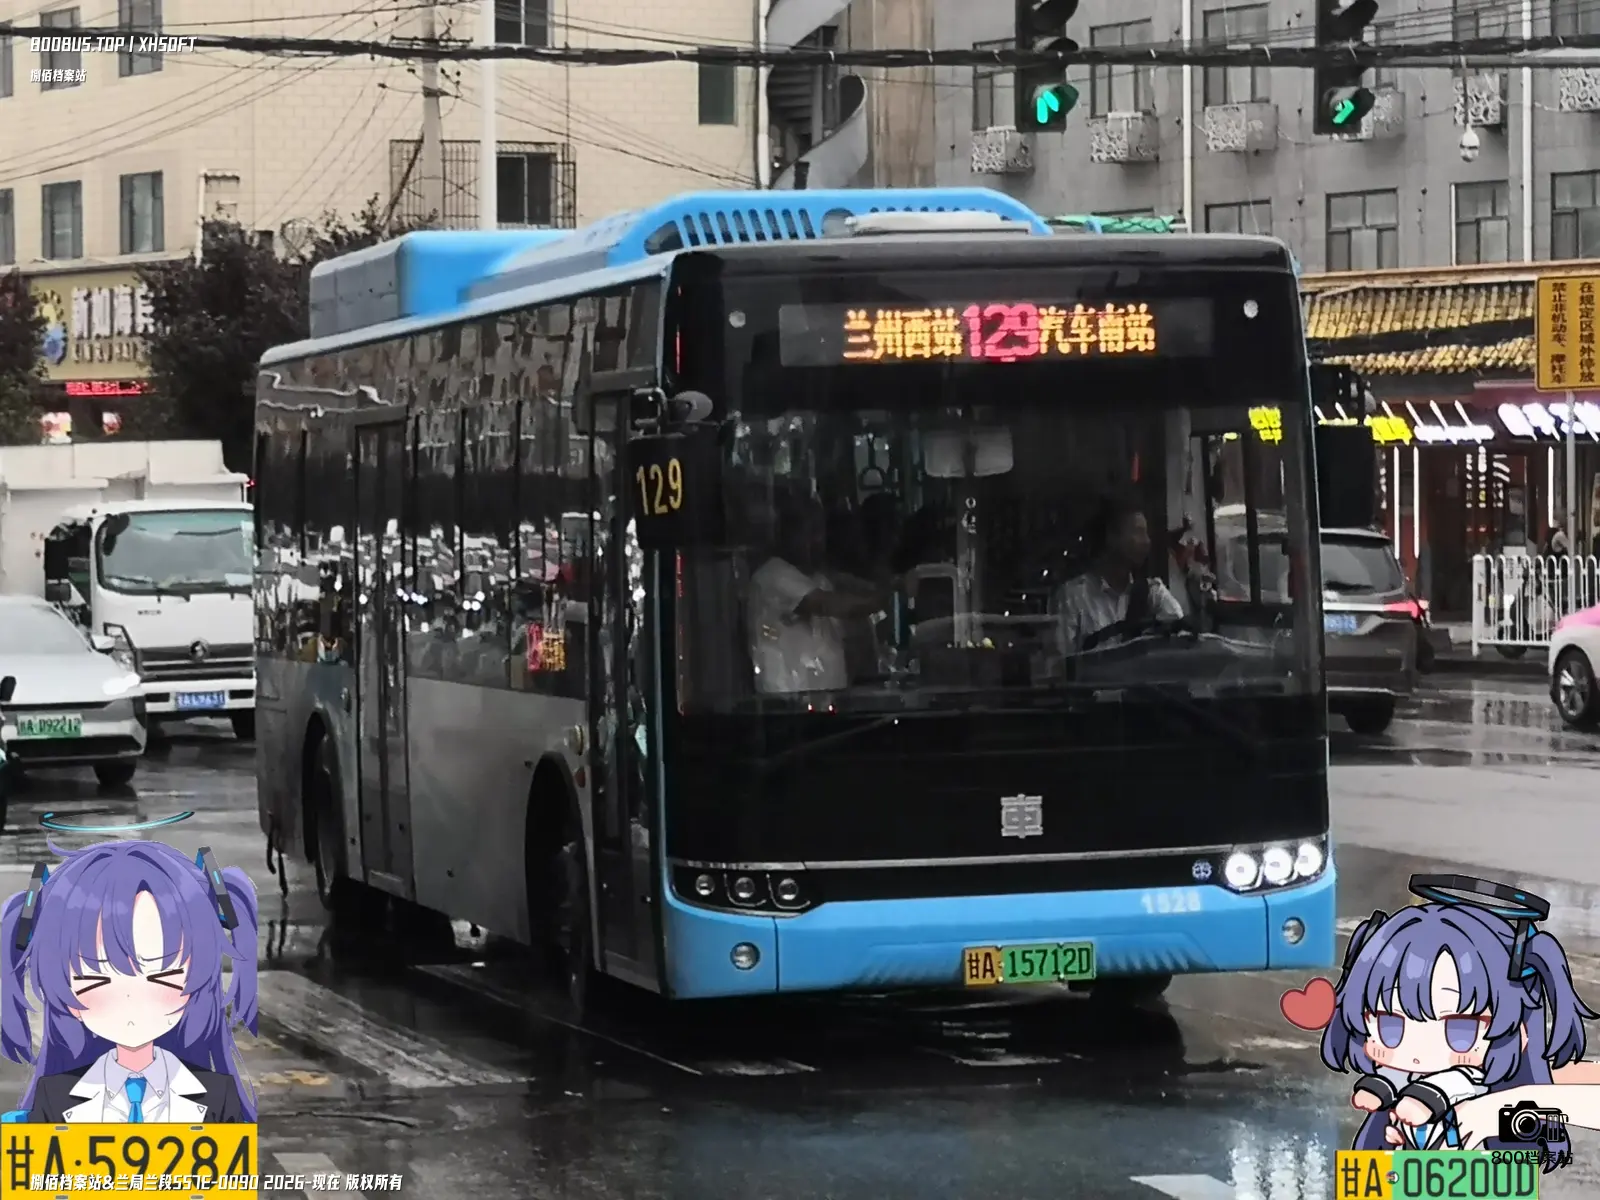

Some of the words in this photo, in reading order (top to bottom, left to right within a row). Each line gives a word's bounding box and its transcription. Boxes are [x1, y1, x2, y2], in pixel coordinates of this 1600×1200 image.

[843, 307, 963, 360] 兰州西站
[636, 457, 683, 516] 129
